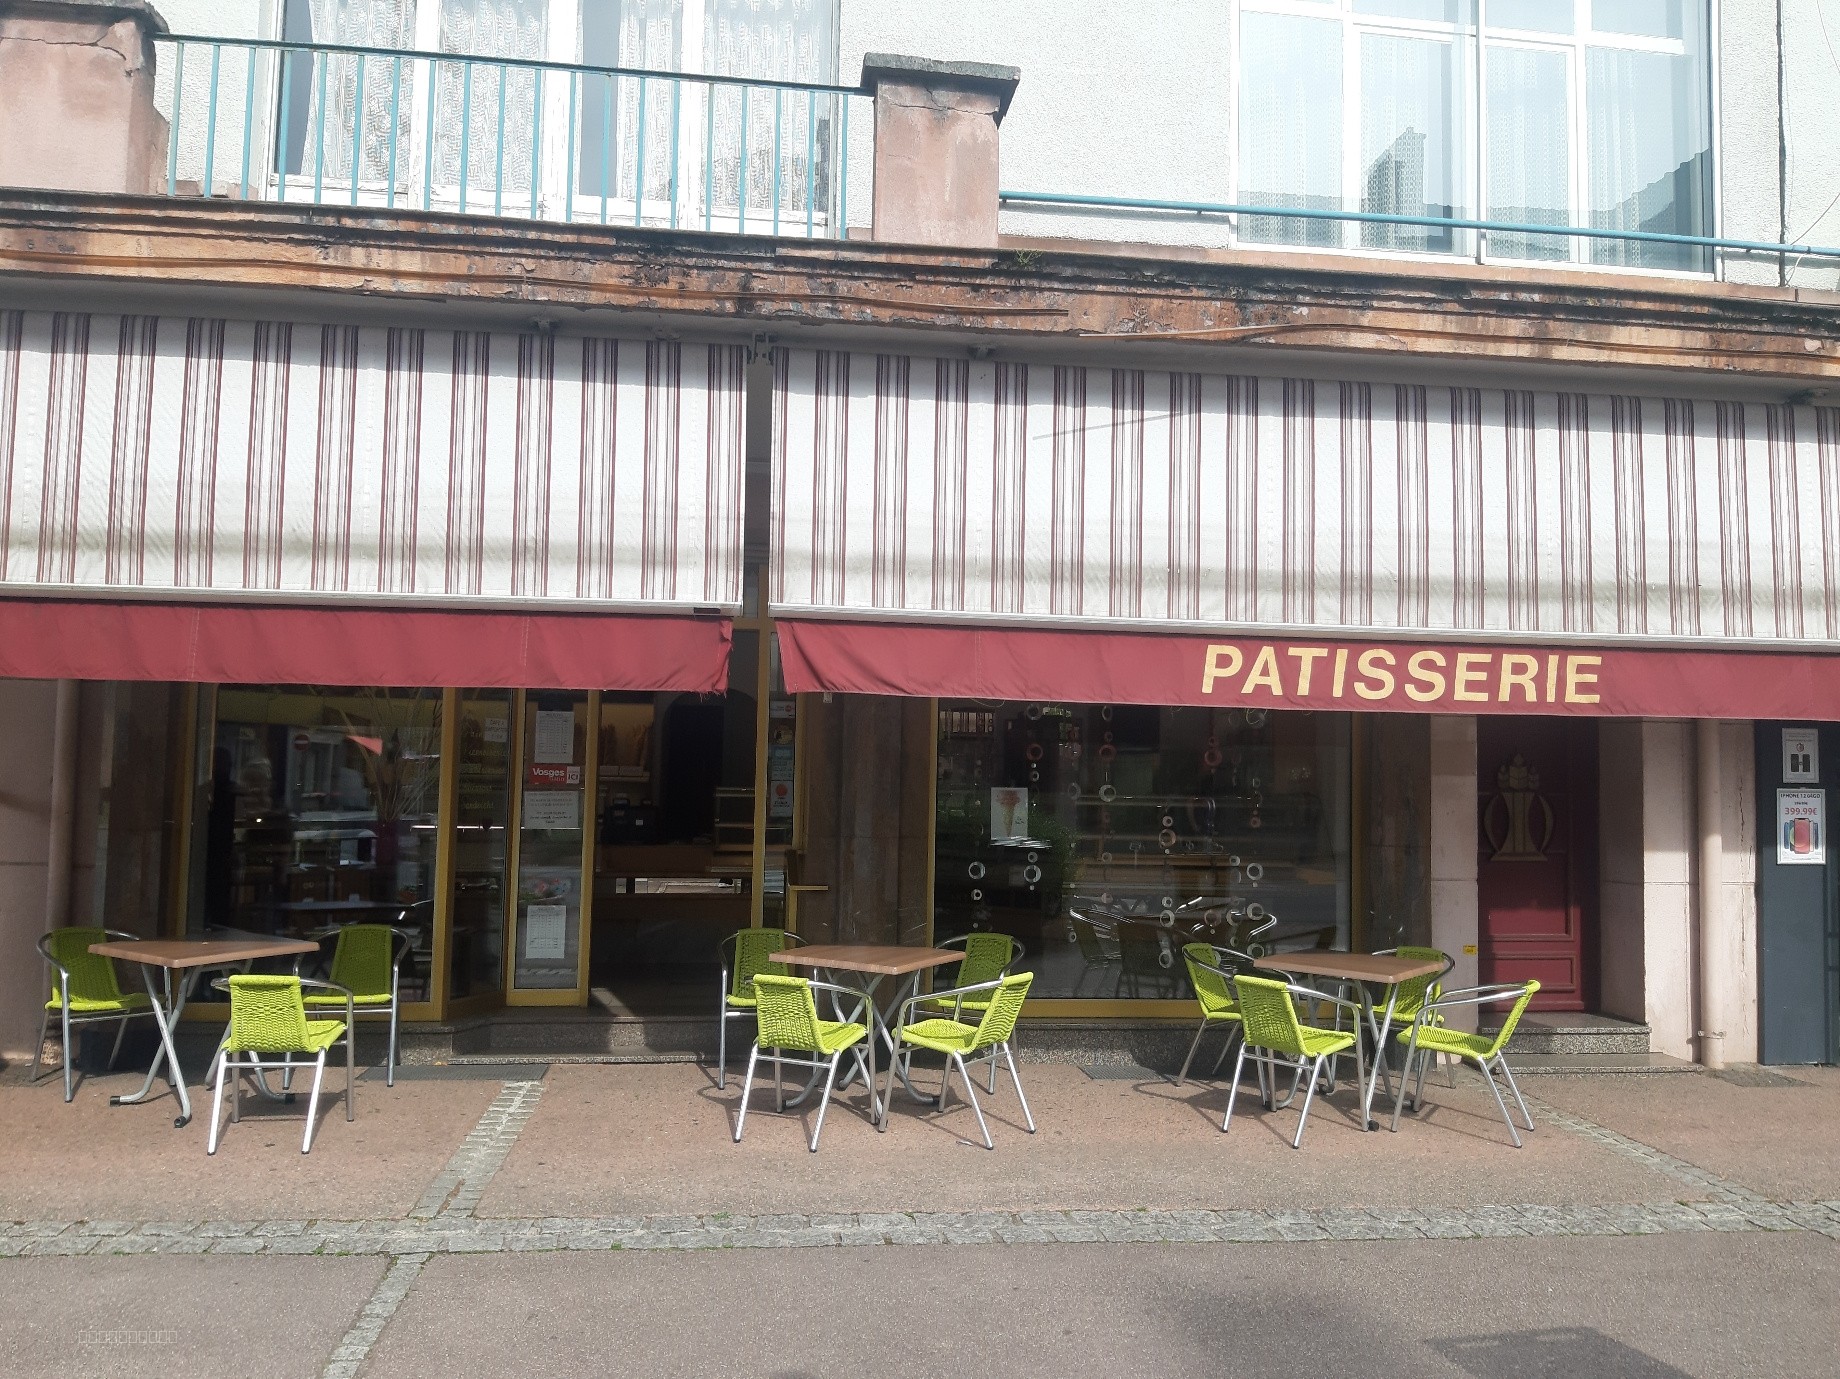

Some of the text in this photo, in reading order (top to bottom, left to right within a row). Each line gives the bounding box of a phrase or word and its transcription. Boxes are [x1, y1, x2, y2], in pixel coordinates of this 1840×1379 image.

[1201, 644, 1602, 704] PATISSERIE
[532, 767, 565, 778] Vosges
[568, 773, 579, 781] ICI
[1784, 807, 1818, 816] 399.99€
